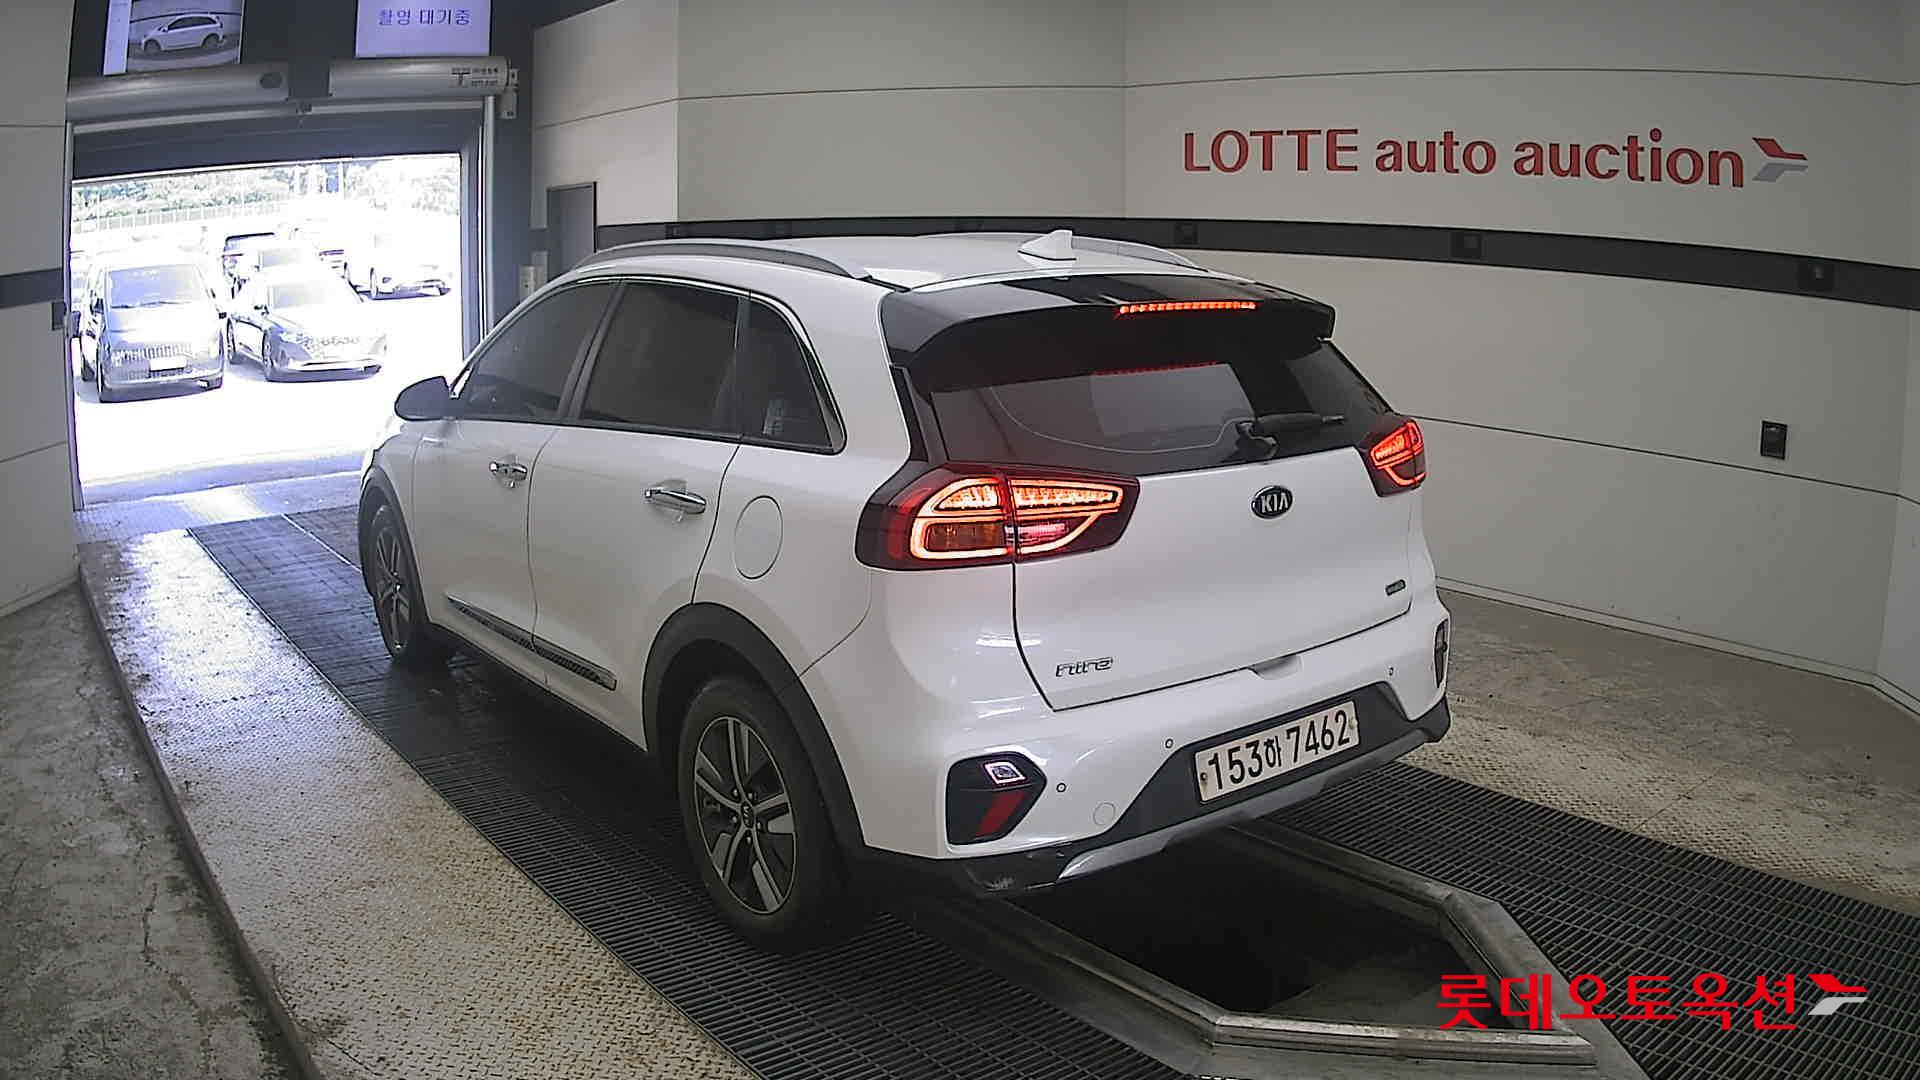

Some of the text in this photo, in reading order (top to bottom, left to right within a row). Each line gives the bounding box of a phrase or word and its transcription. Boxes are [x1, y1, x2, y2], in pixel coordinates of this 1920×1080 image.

[419, 8, 471, 26] 대기중
[1183, 128, 1744, 188] LOTTE auto auction
[1260, 492, 1289, 513] KIA
[1207, 709, 1351, 790] 153하 7462
